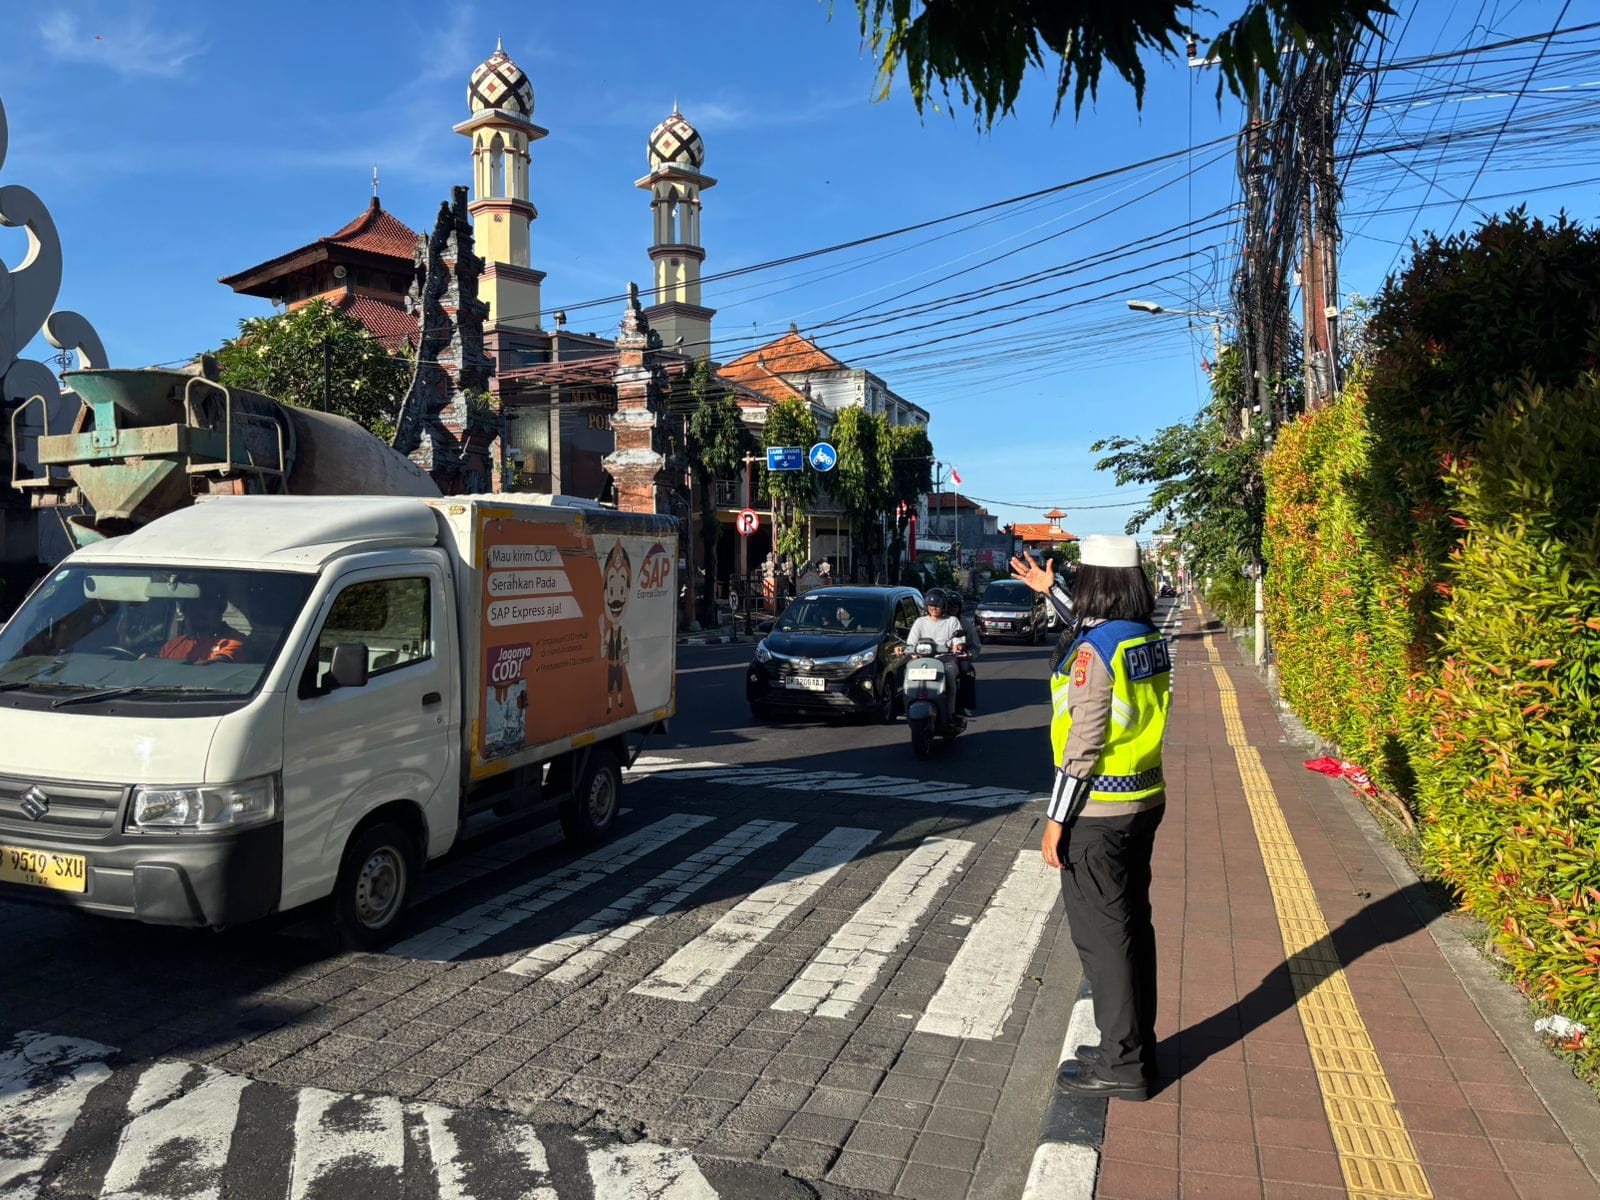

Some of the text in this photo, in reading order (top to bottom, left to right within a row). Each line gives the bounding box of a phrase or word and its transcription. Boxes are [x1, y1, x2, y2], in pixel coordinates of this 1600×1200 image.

[743, 513, 754, 532] P
[492, 549, 511, 562] Mau
[512, 549, 533, 562] kirim
[491, 574, 556, 591] Serahkan Pada
[639, 557, 671, 589] SAP
[491, 602, 562, 621] SAP Express aja!
[498, 646, 531, 663] Jagonya
[492, 659, 522, 682] COD!
[11, 850, 47, 874] 9519
[55, 856, 84, 879] SXU
